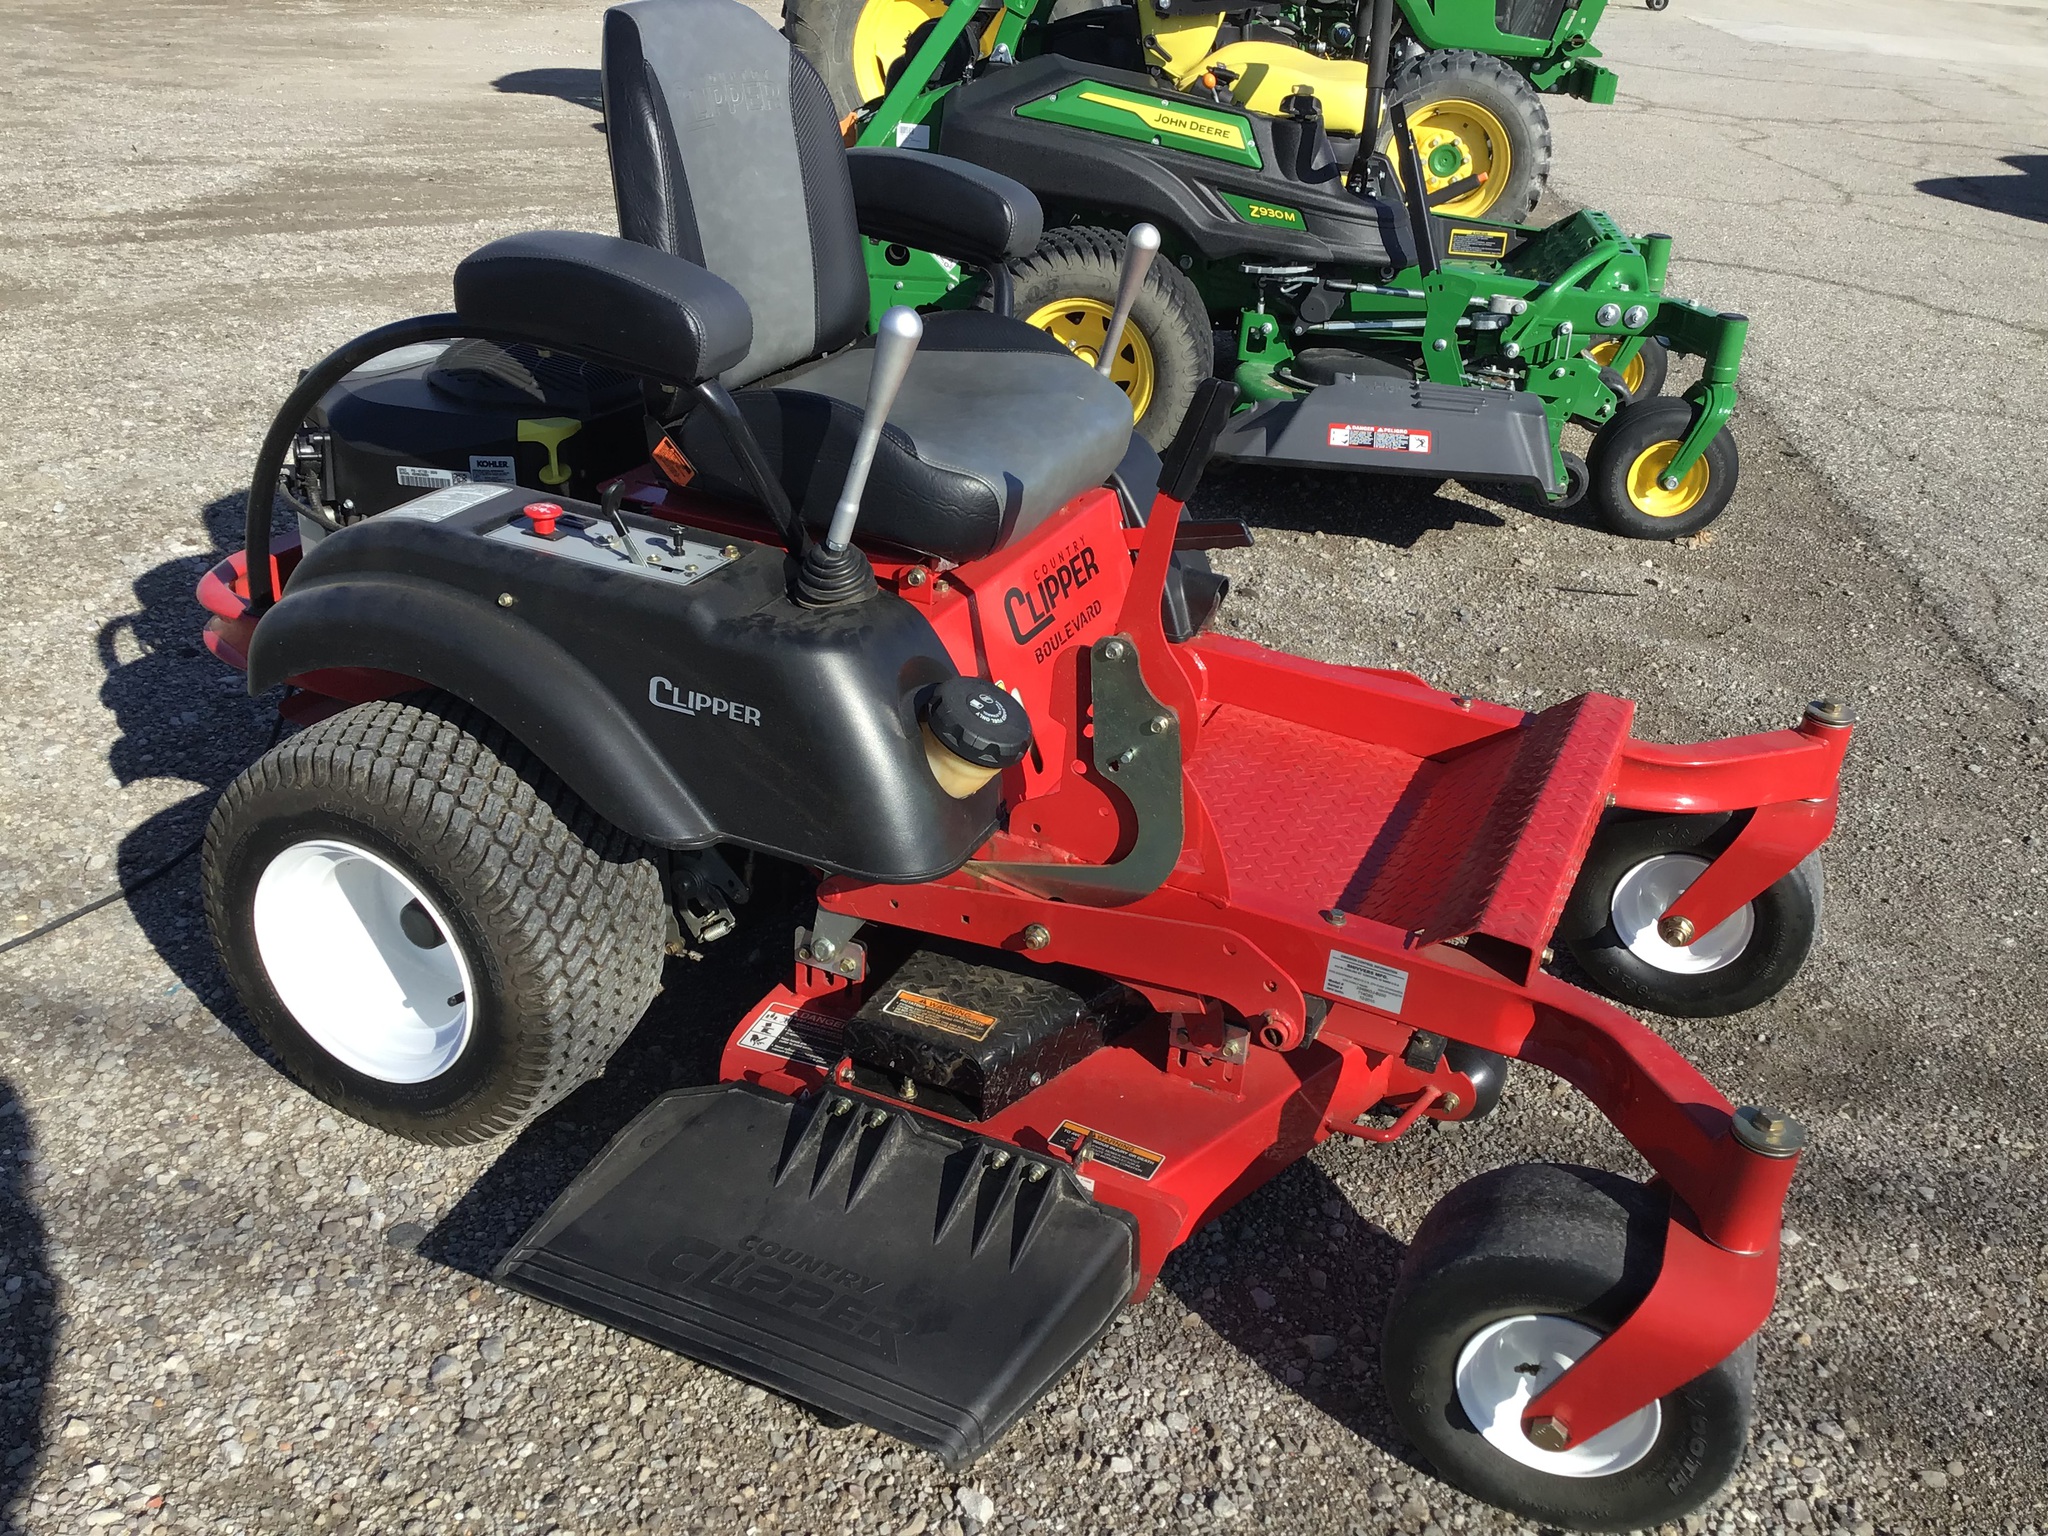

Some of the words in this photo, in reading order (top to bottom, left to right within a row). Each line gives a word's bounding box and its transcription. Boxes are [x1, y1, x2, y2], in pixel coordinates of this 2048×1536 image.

[1154, 113, 1187, 129] JOHN
[1189, 121, 1231, 139] DEERE
[477, 460, 509, 468] KOHLER
[1033, 534, 1086, 581] COUNTRY
[1004, 547, 1100, 646] CLIPPER
[1034, 600, 1102, 664] BOULEVARD
[648, 676, 761, 727] CLIPPER
[928, 1001, 971, 1017] WARNING
[1097, 1135, 1135, 1151] WARNING
[738, 1235, 885, 1294] COUNTRY
[648, 1236, 917, 1366] CLIPPER
